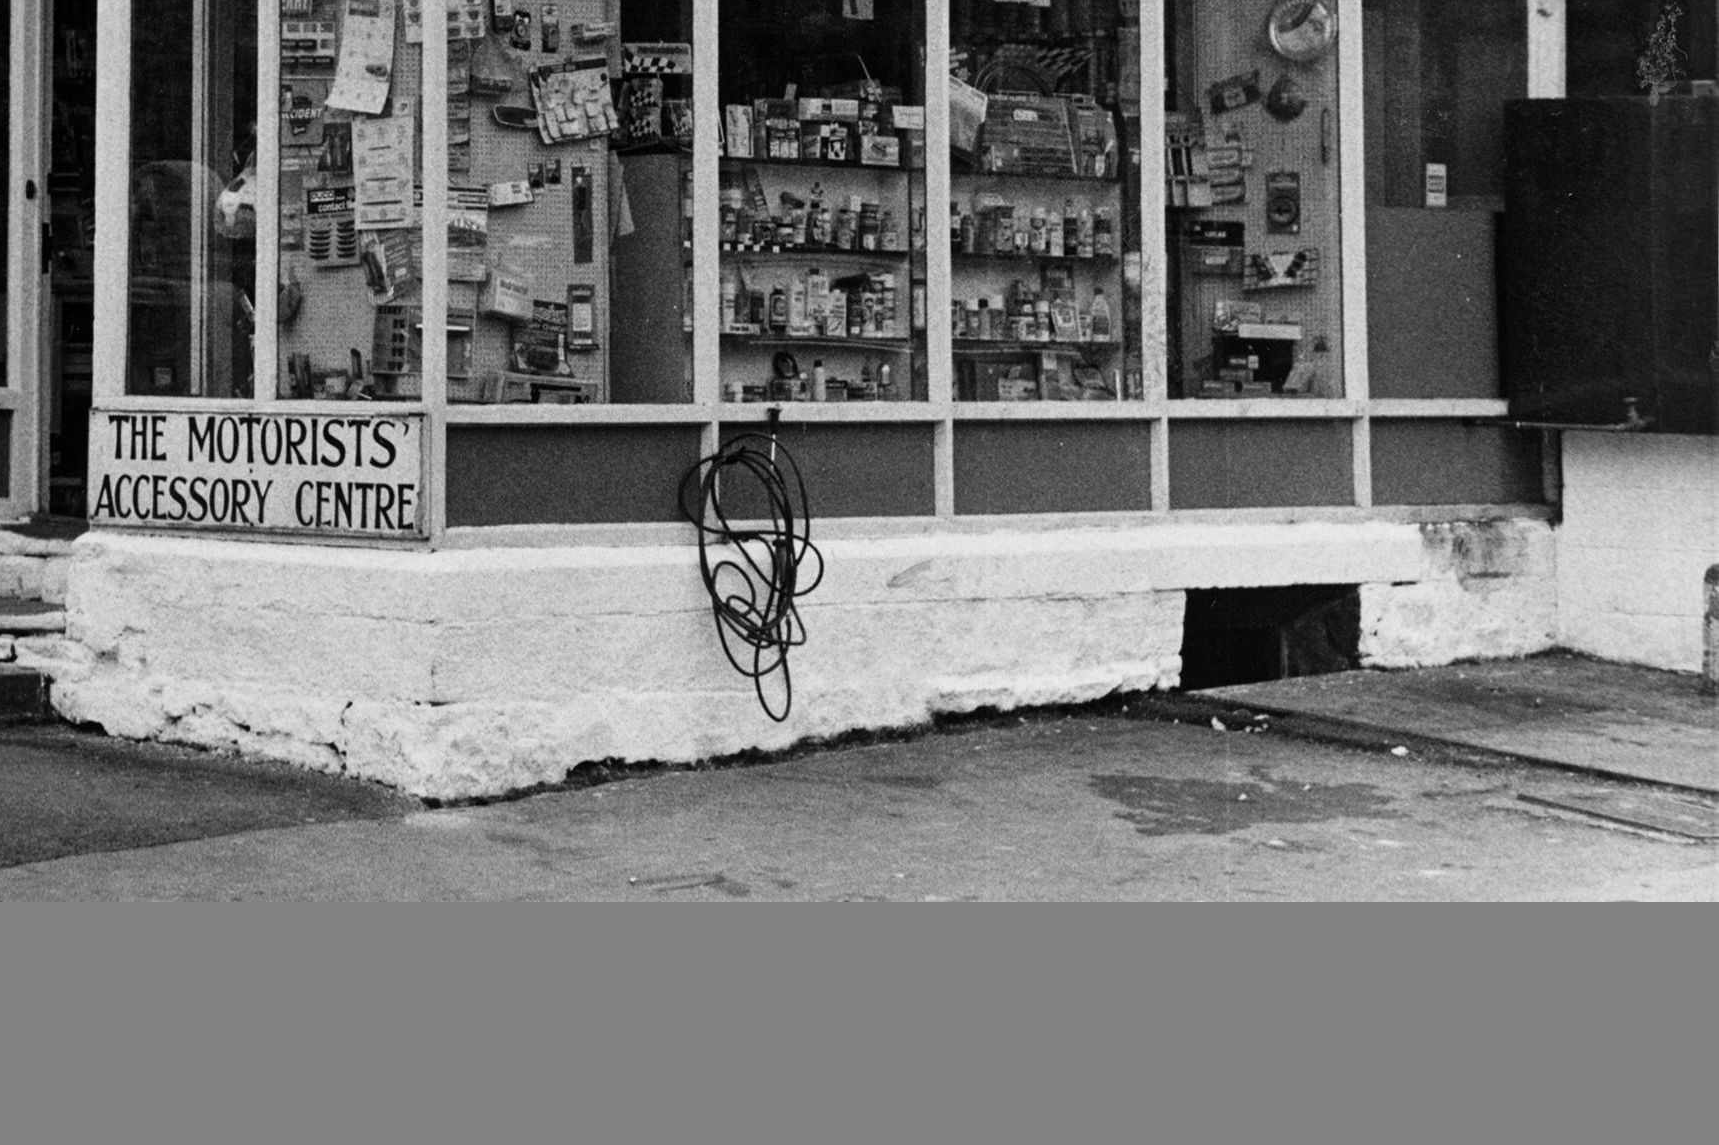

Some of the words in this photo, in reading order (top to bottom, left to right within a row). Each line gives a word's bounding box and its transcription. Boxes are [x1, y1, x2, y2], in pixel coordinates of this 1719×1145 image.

[109, 415, 167, 461] THE
[188, 416, 410, 469] MOTORISTS'
[94, 474, 274, 525] ACCESSORY
[296, 481, 416, 531] CENTRE
